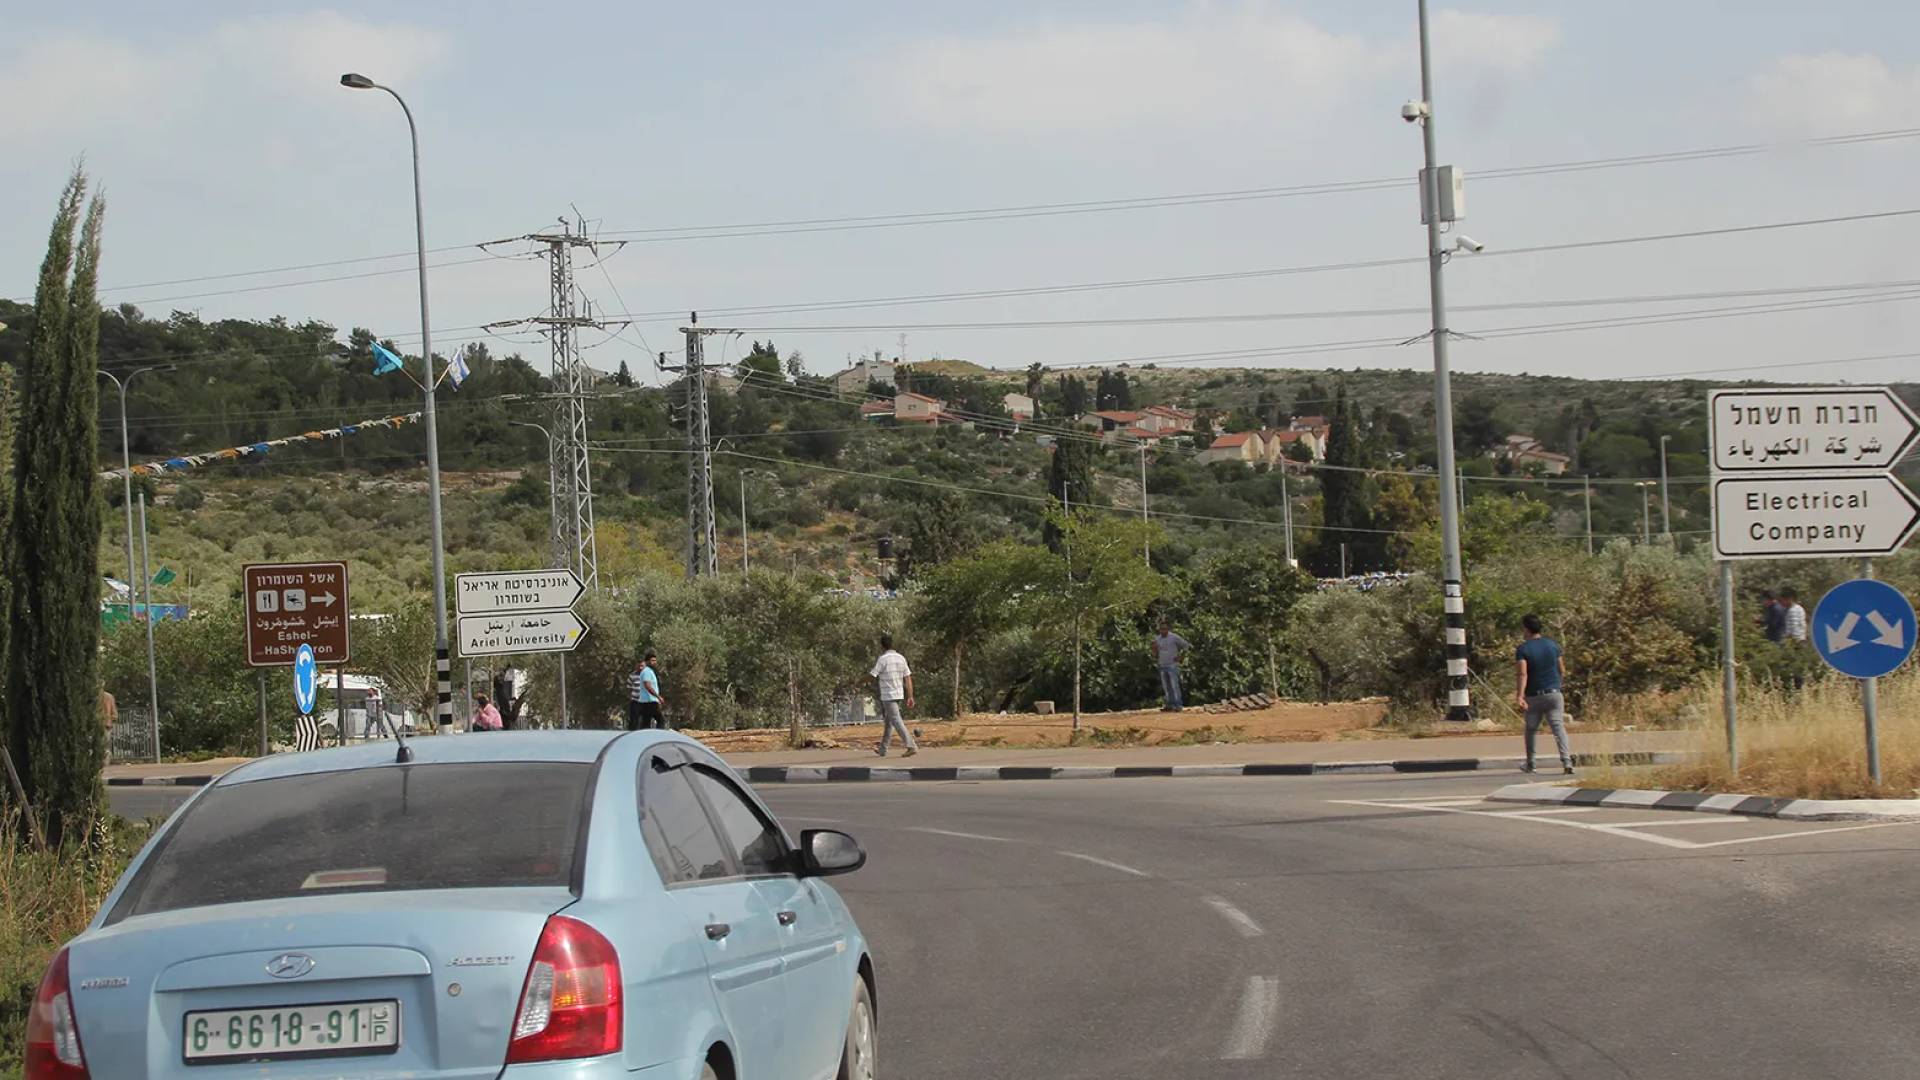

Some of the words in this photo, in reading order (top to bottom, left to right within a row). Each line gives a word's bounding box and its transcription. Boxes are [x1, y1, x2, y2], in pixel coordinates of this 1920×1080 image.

[1730, 404, 1801, 425] חשמל
[1816, 405, 1878, 424] חברת
[1728, 437, 1809, 462] الكهرباء
[1824, 437, 1882, 461] شركة
[1746, 490, 1868, 510] Electrical
[1750, 522, 1866, 544] Company
[256, 574, 303, 587] השומרון
[309, 573, 335, 584] אשל
[463, 580, 499, 592] אריאל
[505, 578, 569, 590] אוניברסיטת
[495, 593, 540, 606] בשומרון
[471, 637, 500, 648] Ariel
[505, 633, 566, 646] University
[264, 645, 333, 655] HaShron
